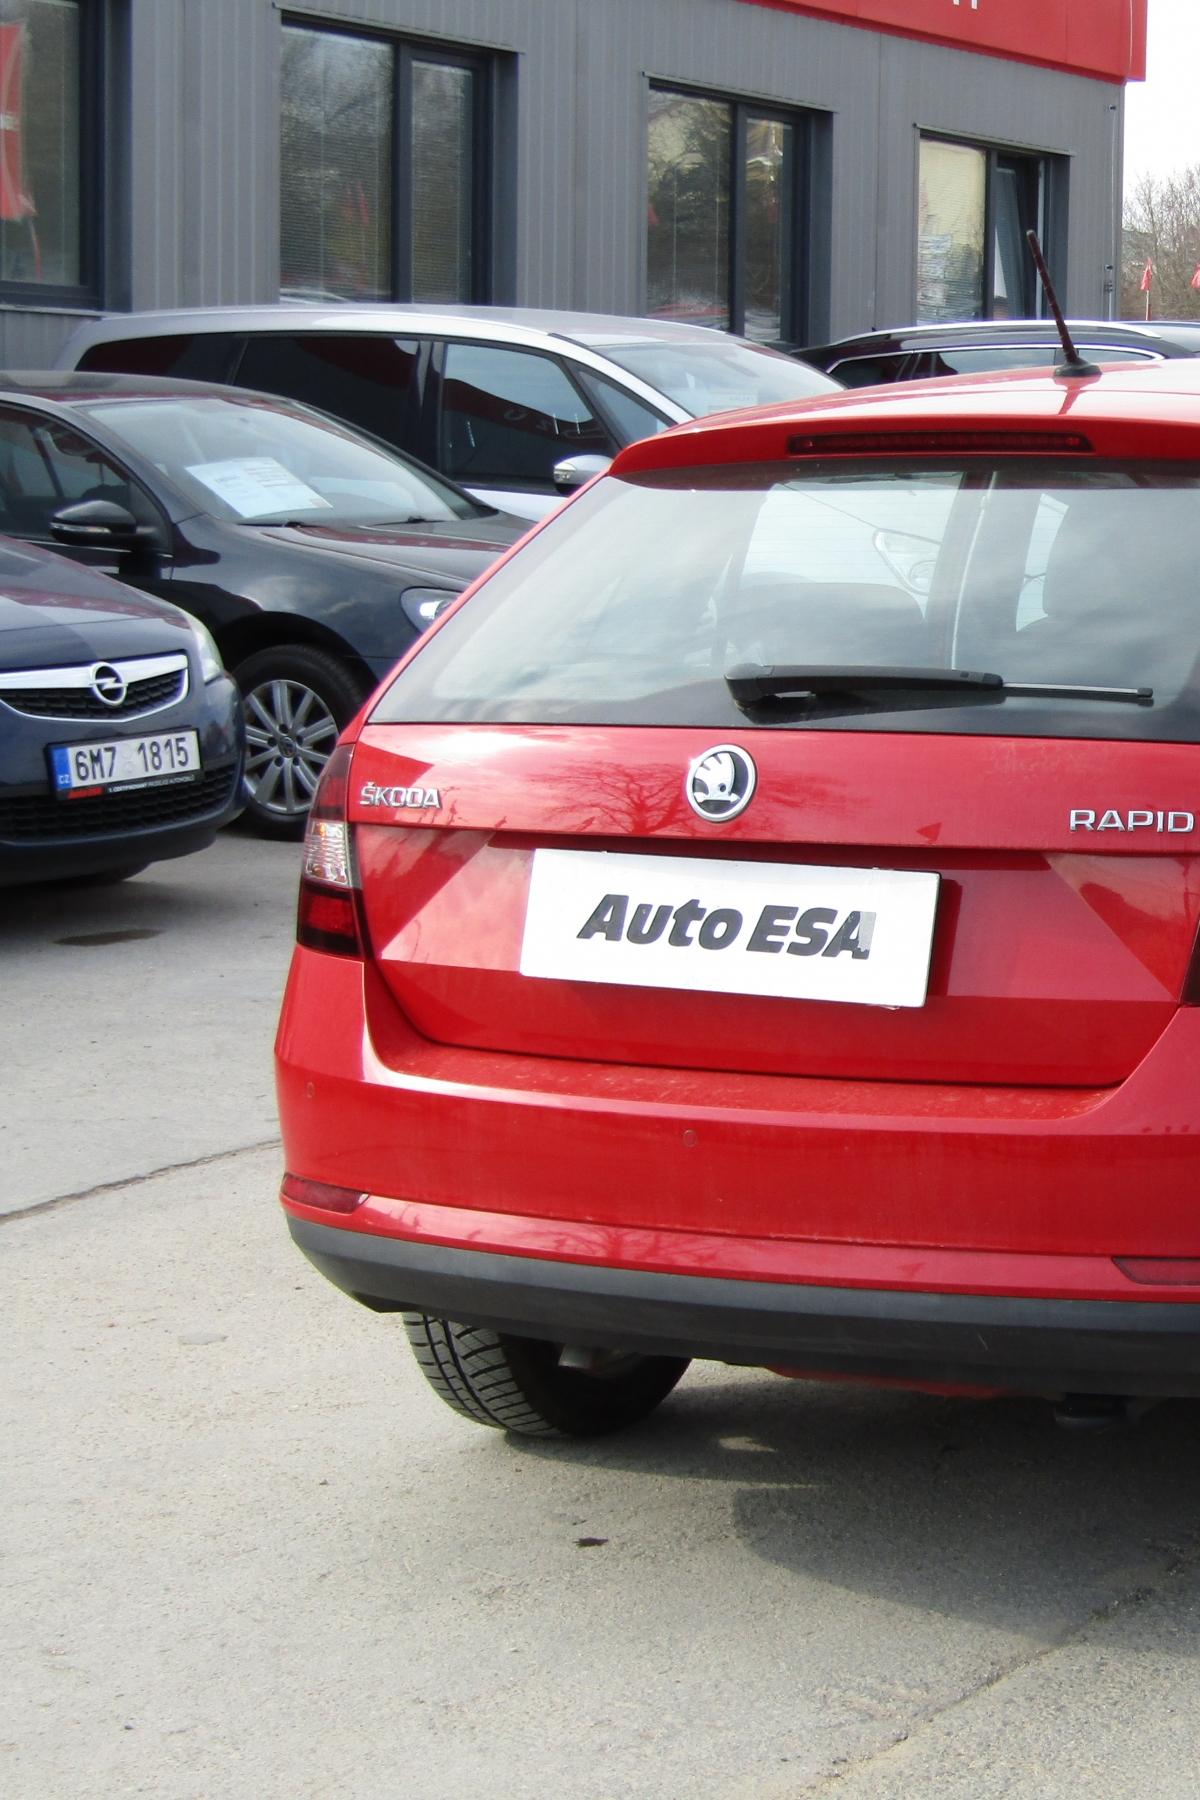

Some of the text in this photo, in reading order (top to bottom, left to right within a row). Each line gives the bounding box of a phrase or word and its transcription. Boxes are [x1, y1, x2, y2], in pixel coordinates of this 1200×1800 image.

[75, 737, 189, 781] 6M7 1815
[360, 782, 442, 808] ŠKODA
[1069, 809, 1195, 833] RAPID
[576, 893, 877, 960] Auto ESA
